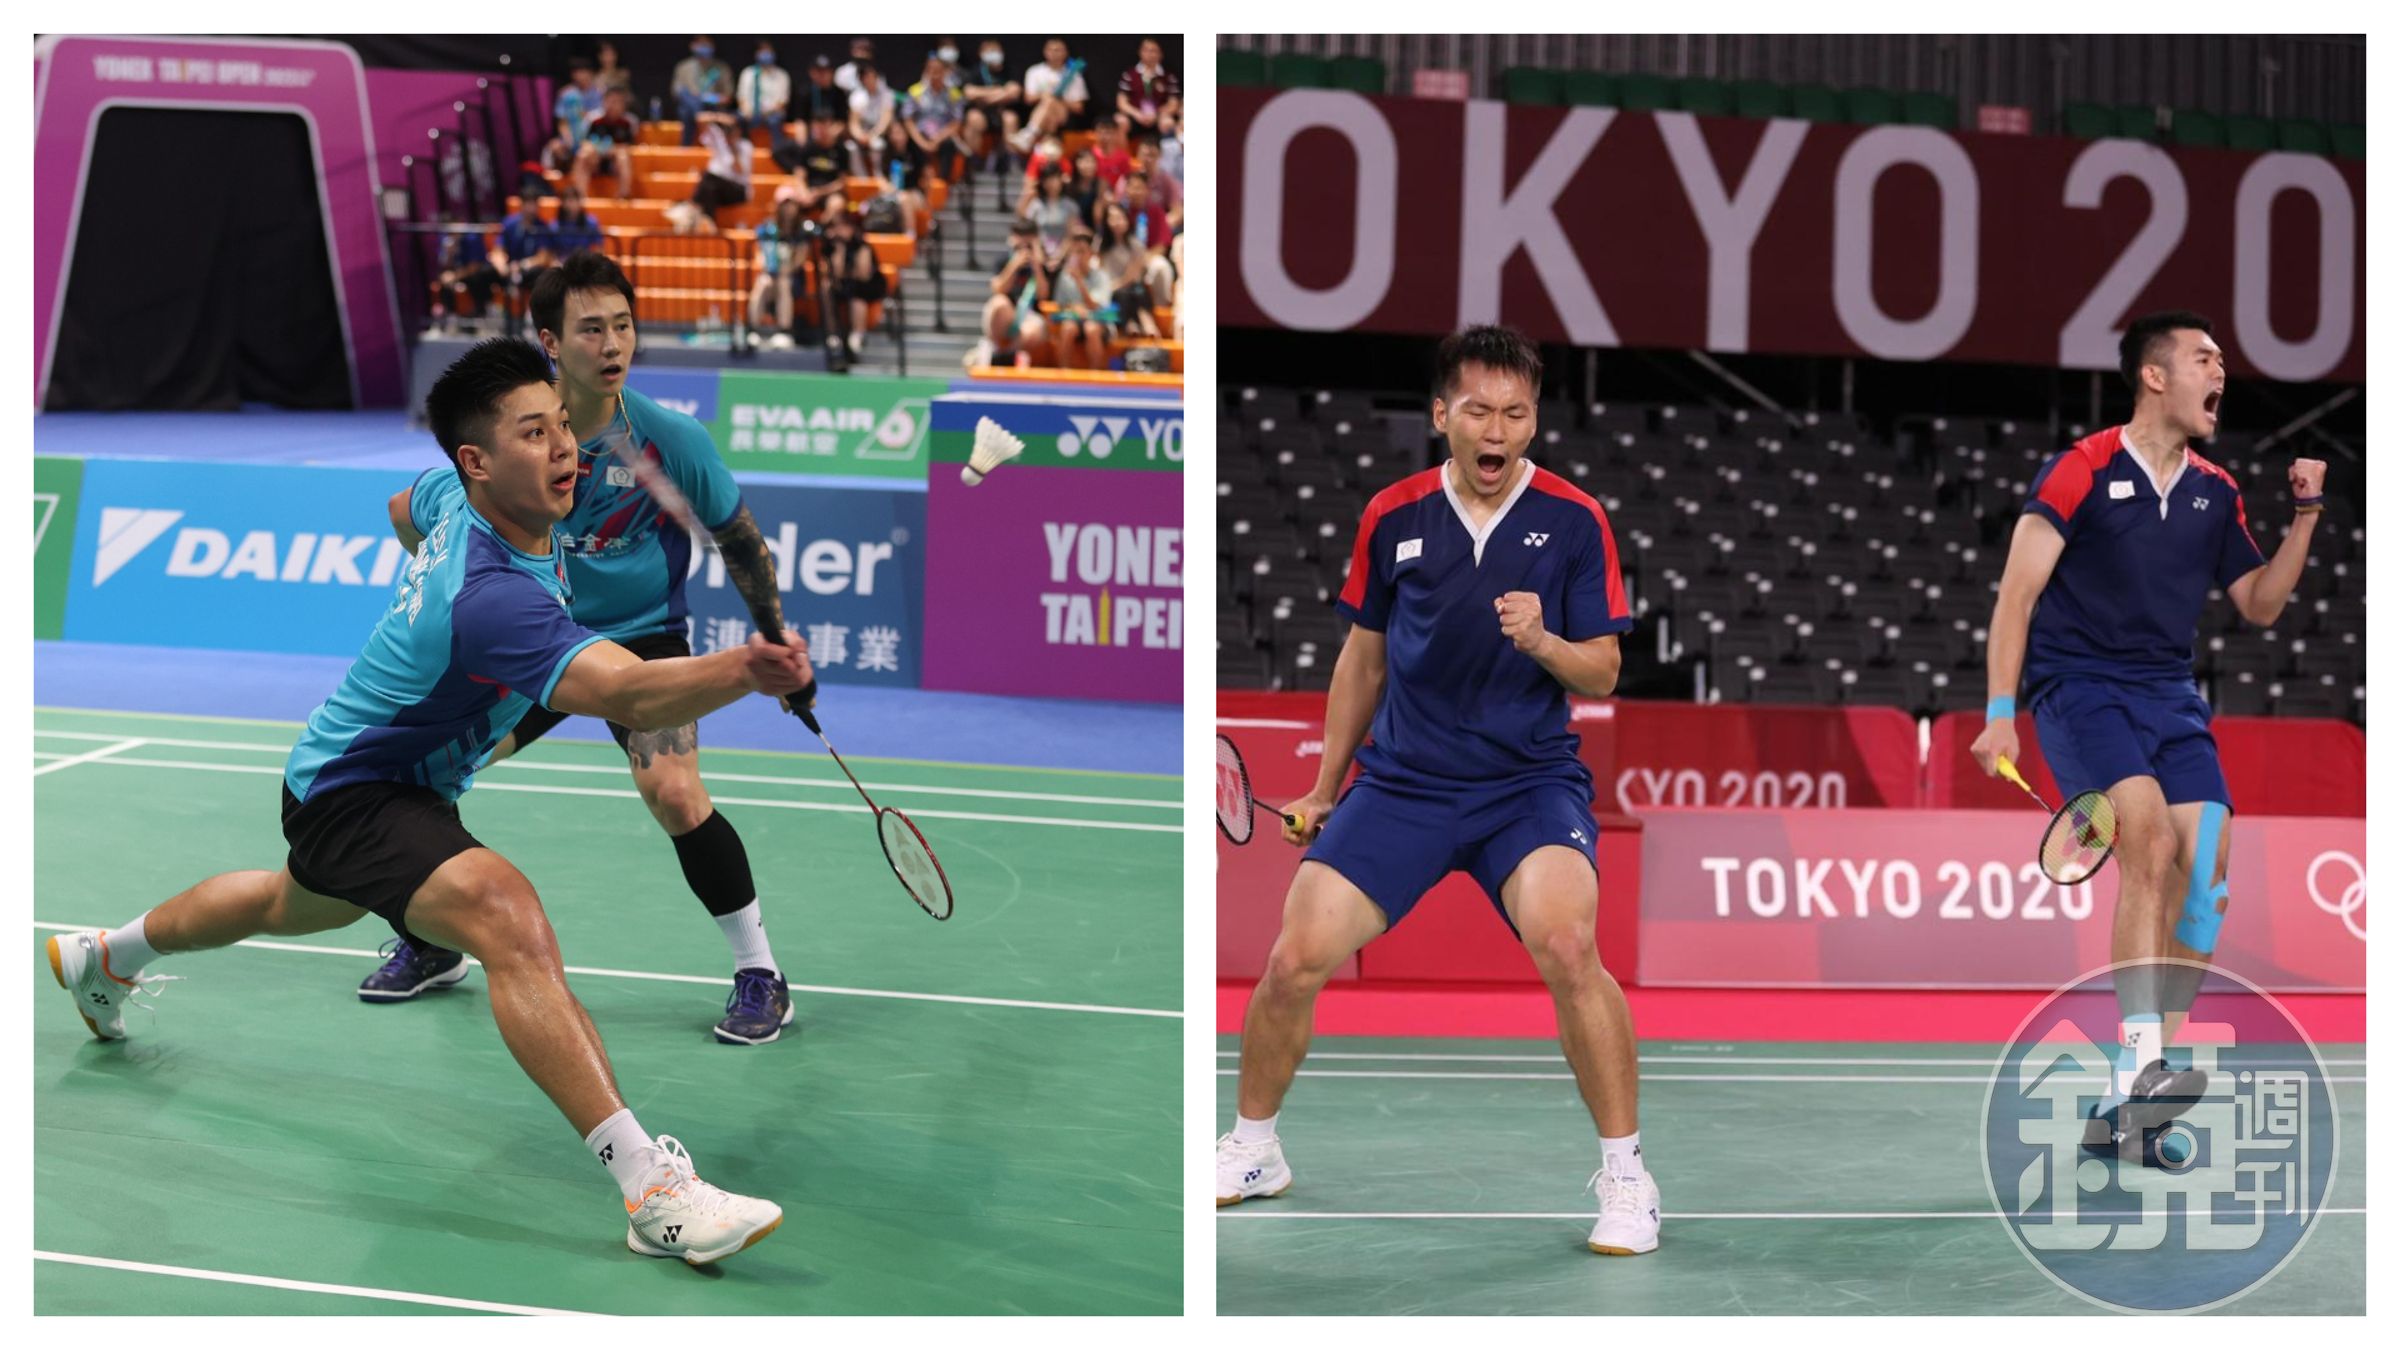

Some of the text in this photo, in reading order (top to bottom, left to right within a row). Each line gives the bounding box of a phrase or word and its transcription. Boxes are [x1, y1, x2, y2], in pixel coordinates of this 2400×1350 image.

[1239, 86, 2356, 383] OKYO 20
[165, 526, 412, 587] DAIKI
[1043, 521, 1184, 588] YONE
[1040, 585, 1184, 650] TAIPEI
[1701, 857, 2095, 921] TOKYO 2020
